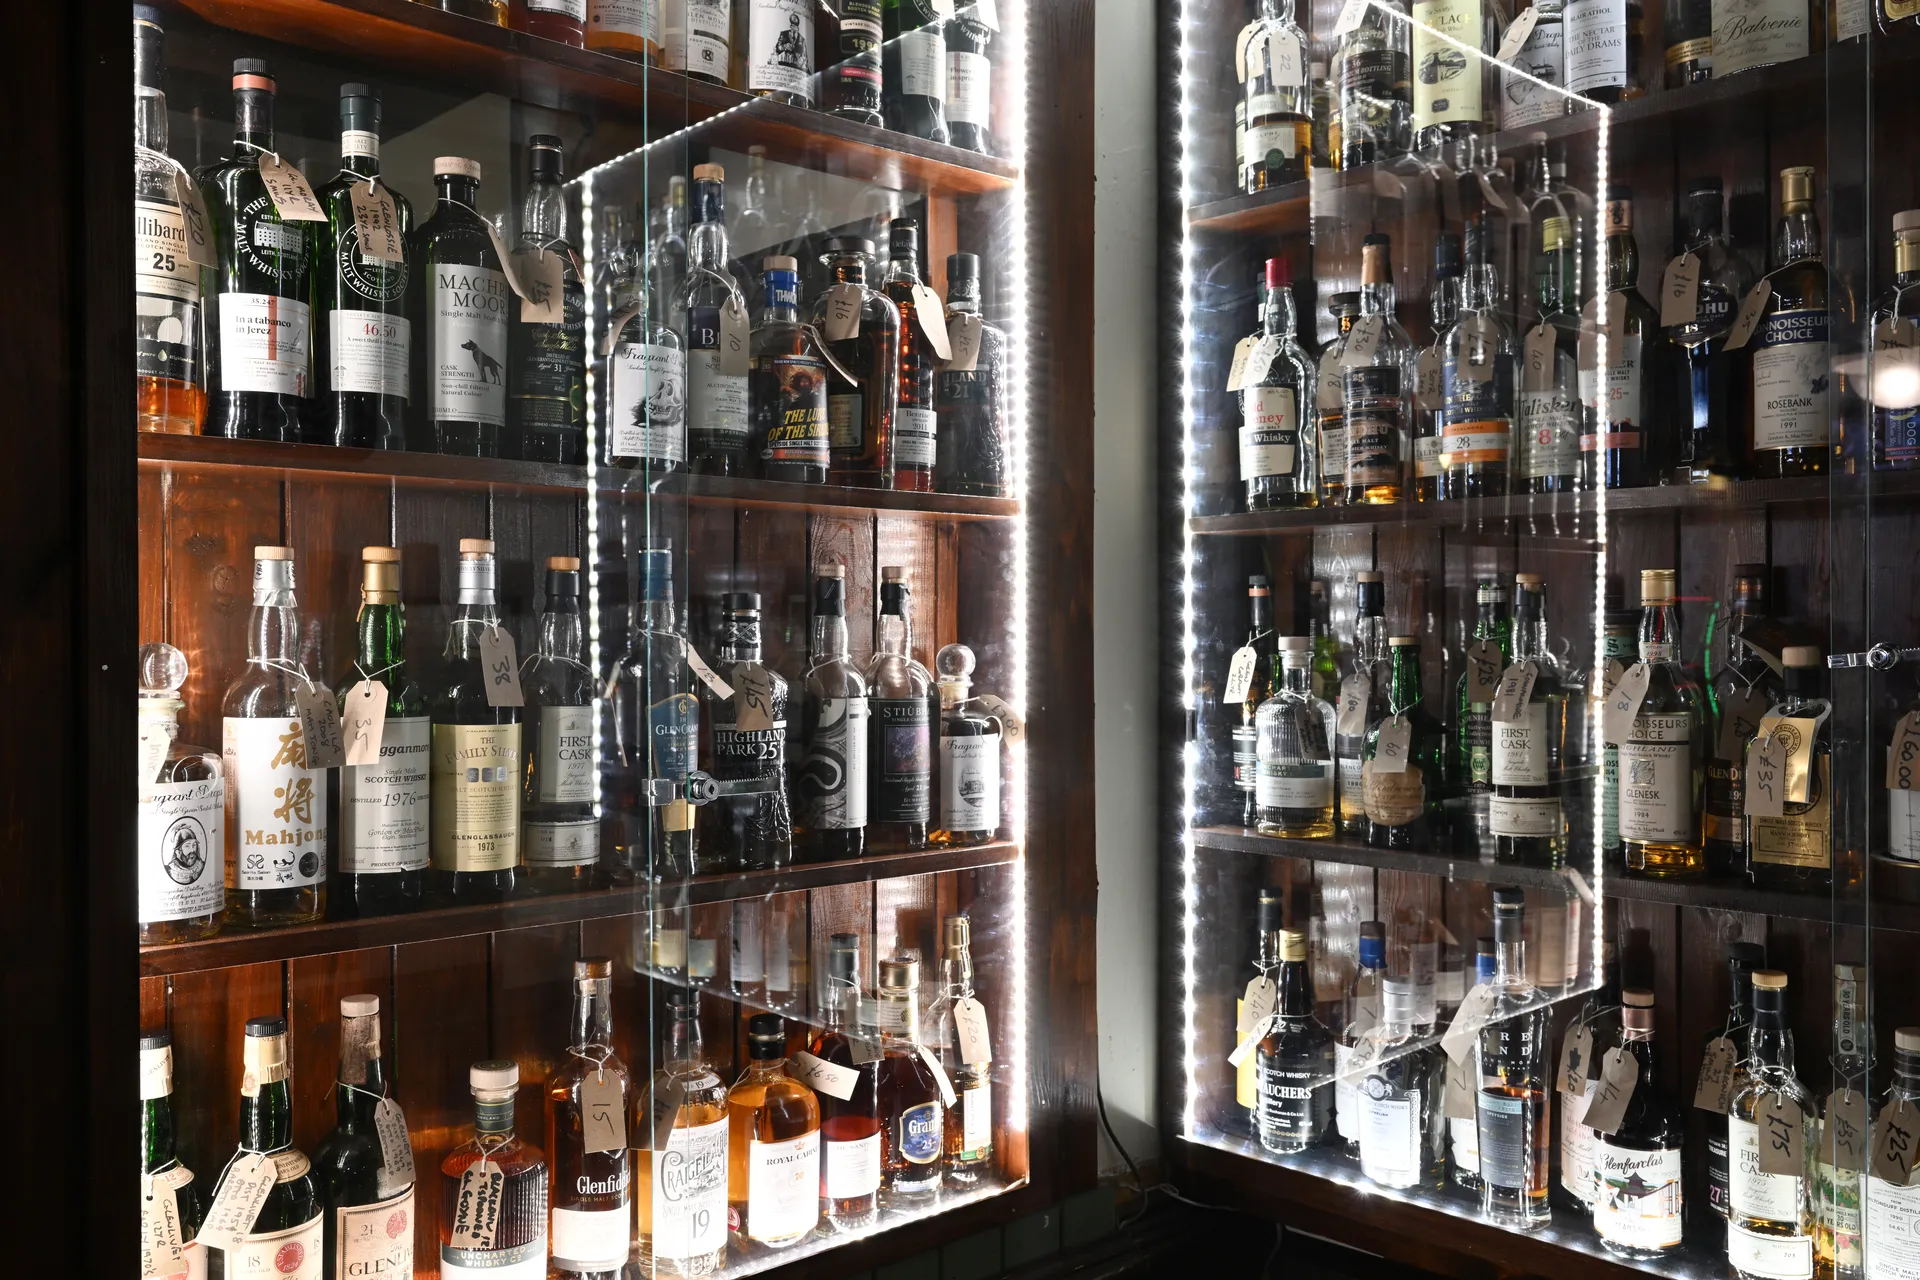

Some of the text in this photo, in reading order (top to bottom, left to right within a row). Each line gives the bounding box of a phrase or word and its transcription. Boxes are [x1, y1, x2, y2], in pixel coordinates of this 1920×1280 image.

[1583, 26, 1616, 38] NECTAR
[1724, 15, 1803, 45] Balvenie
[1587, 39, 1622, 52] DRAMS
[243, 196, 269, 216] THE
[235, 221, 294, 282] MALT WHISKY
[152, 252, 176, 273] 25
[440, 310, 481, 320] Single Malt
[1695, 301, 1730, 316] DHU
[254, 317, 292, 329] tabanco
[1683, 323, 1698, 334] 18
[246, 324, 272, 337] Jerez
[361, 322, 397, 339] 46.50
[1765, 328, 1814, 343] CHOICE
[553, 363, 562, 373] 31
[1610, 387, 1623, 401] 25
[1767, 398, 1812, 410] ROSEBANK
[785, 409, 806, 425] THE
[1780, 421, 1797, 429] 1991
[768, 425, 805, 442] OF THE
[1254, 431, 1292, 445] Whisky
[1538, 428, 1552, 446] 8
[1906, 421, 1917, 446] DOG
[1456, 436, 1471, 449] 28
[492, 654, 512, 687] 38
[1633, 719, 1688, 729] OISSEURS
[354, 718, 372, 753] 35
[716, 729, 786, 743] HIGHLAND
[1501, 728, 1531, 738] FIRST
[1629, 730, 1664, 740] HOICE
[480, 736, 496, 745] THE
[1501, 739, 1531, 750] CASK
[558, 748, 593, 761] CASK
[716, 741, 779, 760] PARK 25
[365, 776, 402, 784] SCOTCH
[382, 791, 417, 808] 1976
[1626, 789, 1660, 800] GLENESK
[451, 831, 515, 841] GLENGLASSAUGH
[477, 842, 495, 852] 1973
[1842, 998, 1851, 1020] YEARS
[963, 1014, 980, 1043] £20
[1842, 1021, 1851, 1035] OLD
[1263, 1069, 1310, 1079] SCOTCH WHISKY
[695, 1080, 705, 1089] 19
[1262, 1084, 1312, 1100] AUCHERS
[592, 1102, 616, 1137] 15
[908, 1119, 937, 1135] Gran
[1766, 1113, 1794, 1159] £75
[921, 1139, 933, 1150] 25
[1886, 1120, 1909, 1175] £25
[766, 1155, 796, 1167] ROYAL
[1600, 1153, 1664, 1175] Glenfarclas
[793, 1171, 805, 1181] 20
[1709, 1184, 1721, 1204] 27
[360, 1224, 374, 1237] 21
[691, 1209, 711, 1240] 19
[1845, 1222, 1857, 1231] OLD
[460, 1246, 527, 1261] UNCHARTED
[248, 1255, 262, 1268] 18
[465, 1256, 508, 1268] WHISKY
